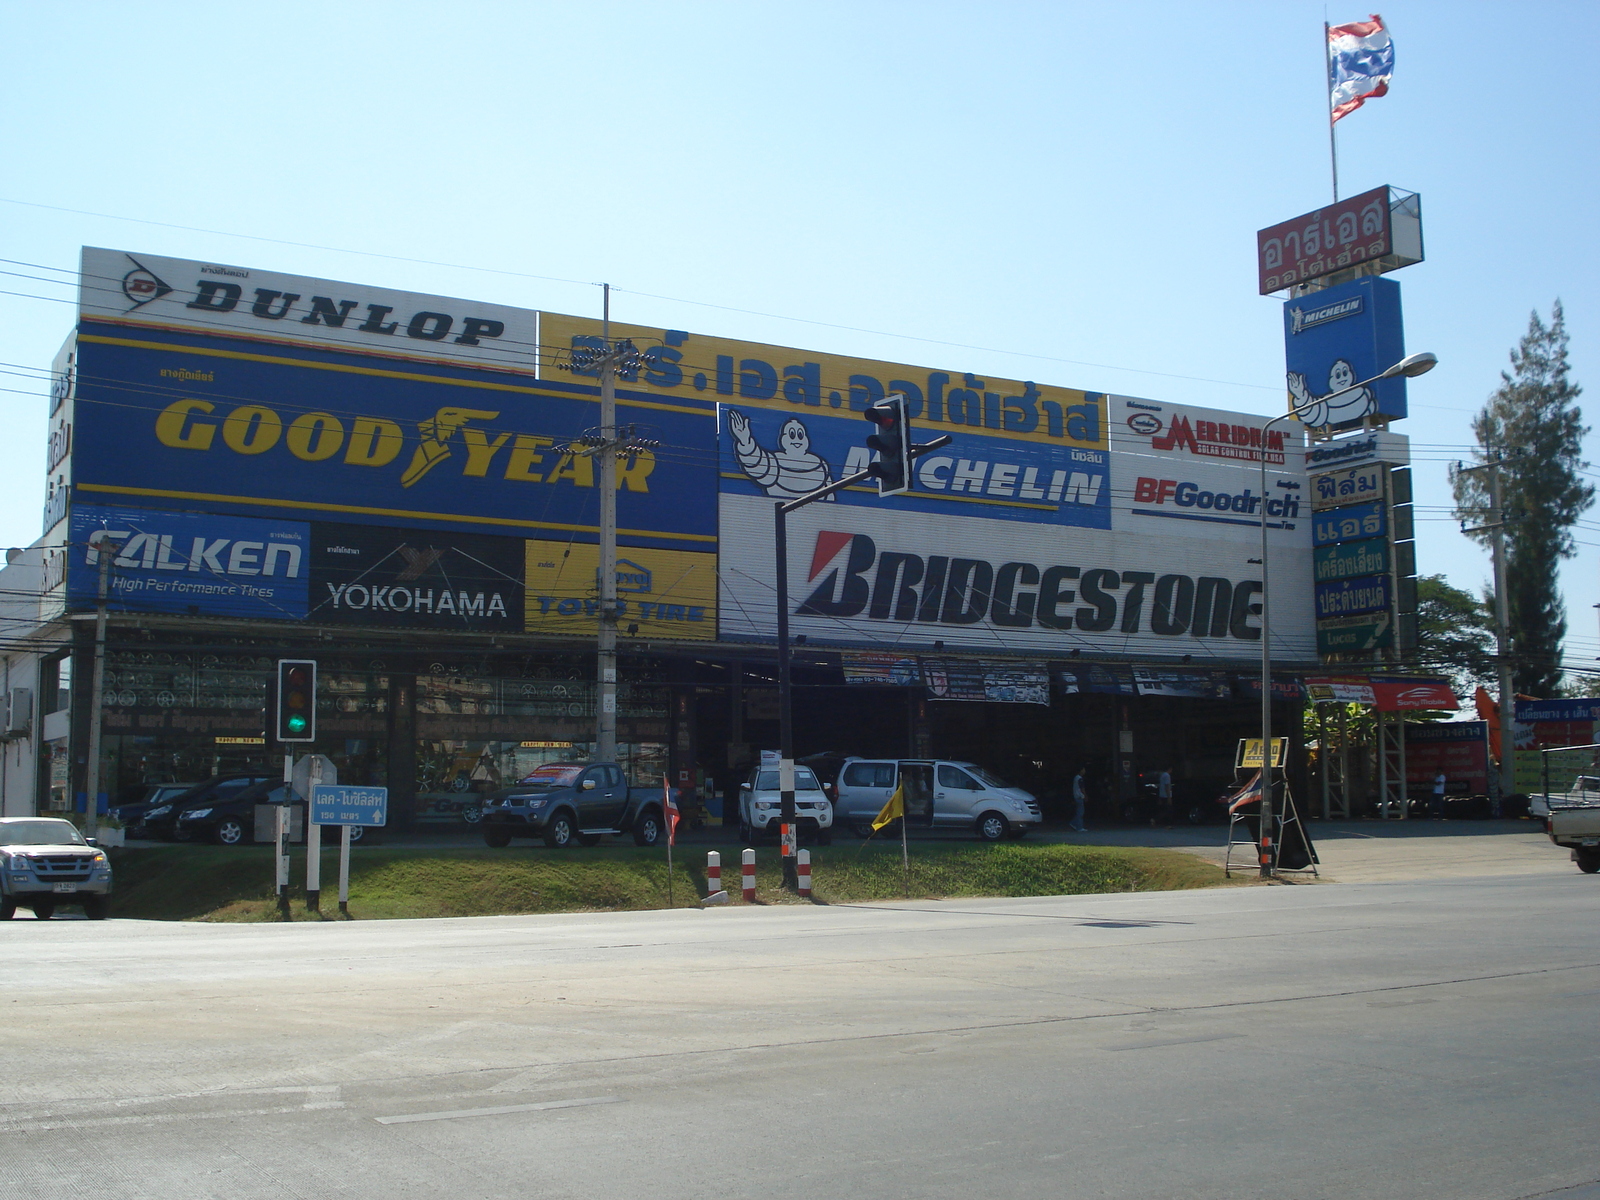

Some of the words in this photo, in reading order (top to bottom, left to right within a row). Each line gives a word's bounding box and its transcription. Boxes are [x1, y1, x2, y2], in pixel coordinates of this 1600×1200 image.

[186, 279, 505, 346] DUNLOP
[1304, 299, 1360, 323] MICHELIN
[1197, 444, 1220, 455] SOLAR
[1221, 447, 1250, 459] CONTROL
[841, 446, 1102, 505] MCHELIN
[1317, 470, 1377, 499] ฟิล์ม
[1134, 476, 1298, 519] BFGoodrich
[1317, 505, 1381, 542] แอร์
[1317, 546, 1383, 578] เครื่องเสียง
[112, 576, 143, 592] High
[146, 578, 236, 595] Performance
[241, 584, 275, 598] Tires
[326, 582, 508, 619] YOKOHAMA
[795, 530, 1263, 640] BRIDGESTONE
[1320, 576, 1385, 614] ประดับยนต์
[638, 601, 706, 622] TIRE
[1327, 632, 1357, 646] Lucas
[1247, 742, 1278, 755] AEO
